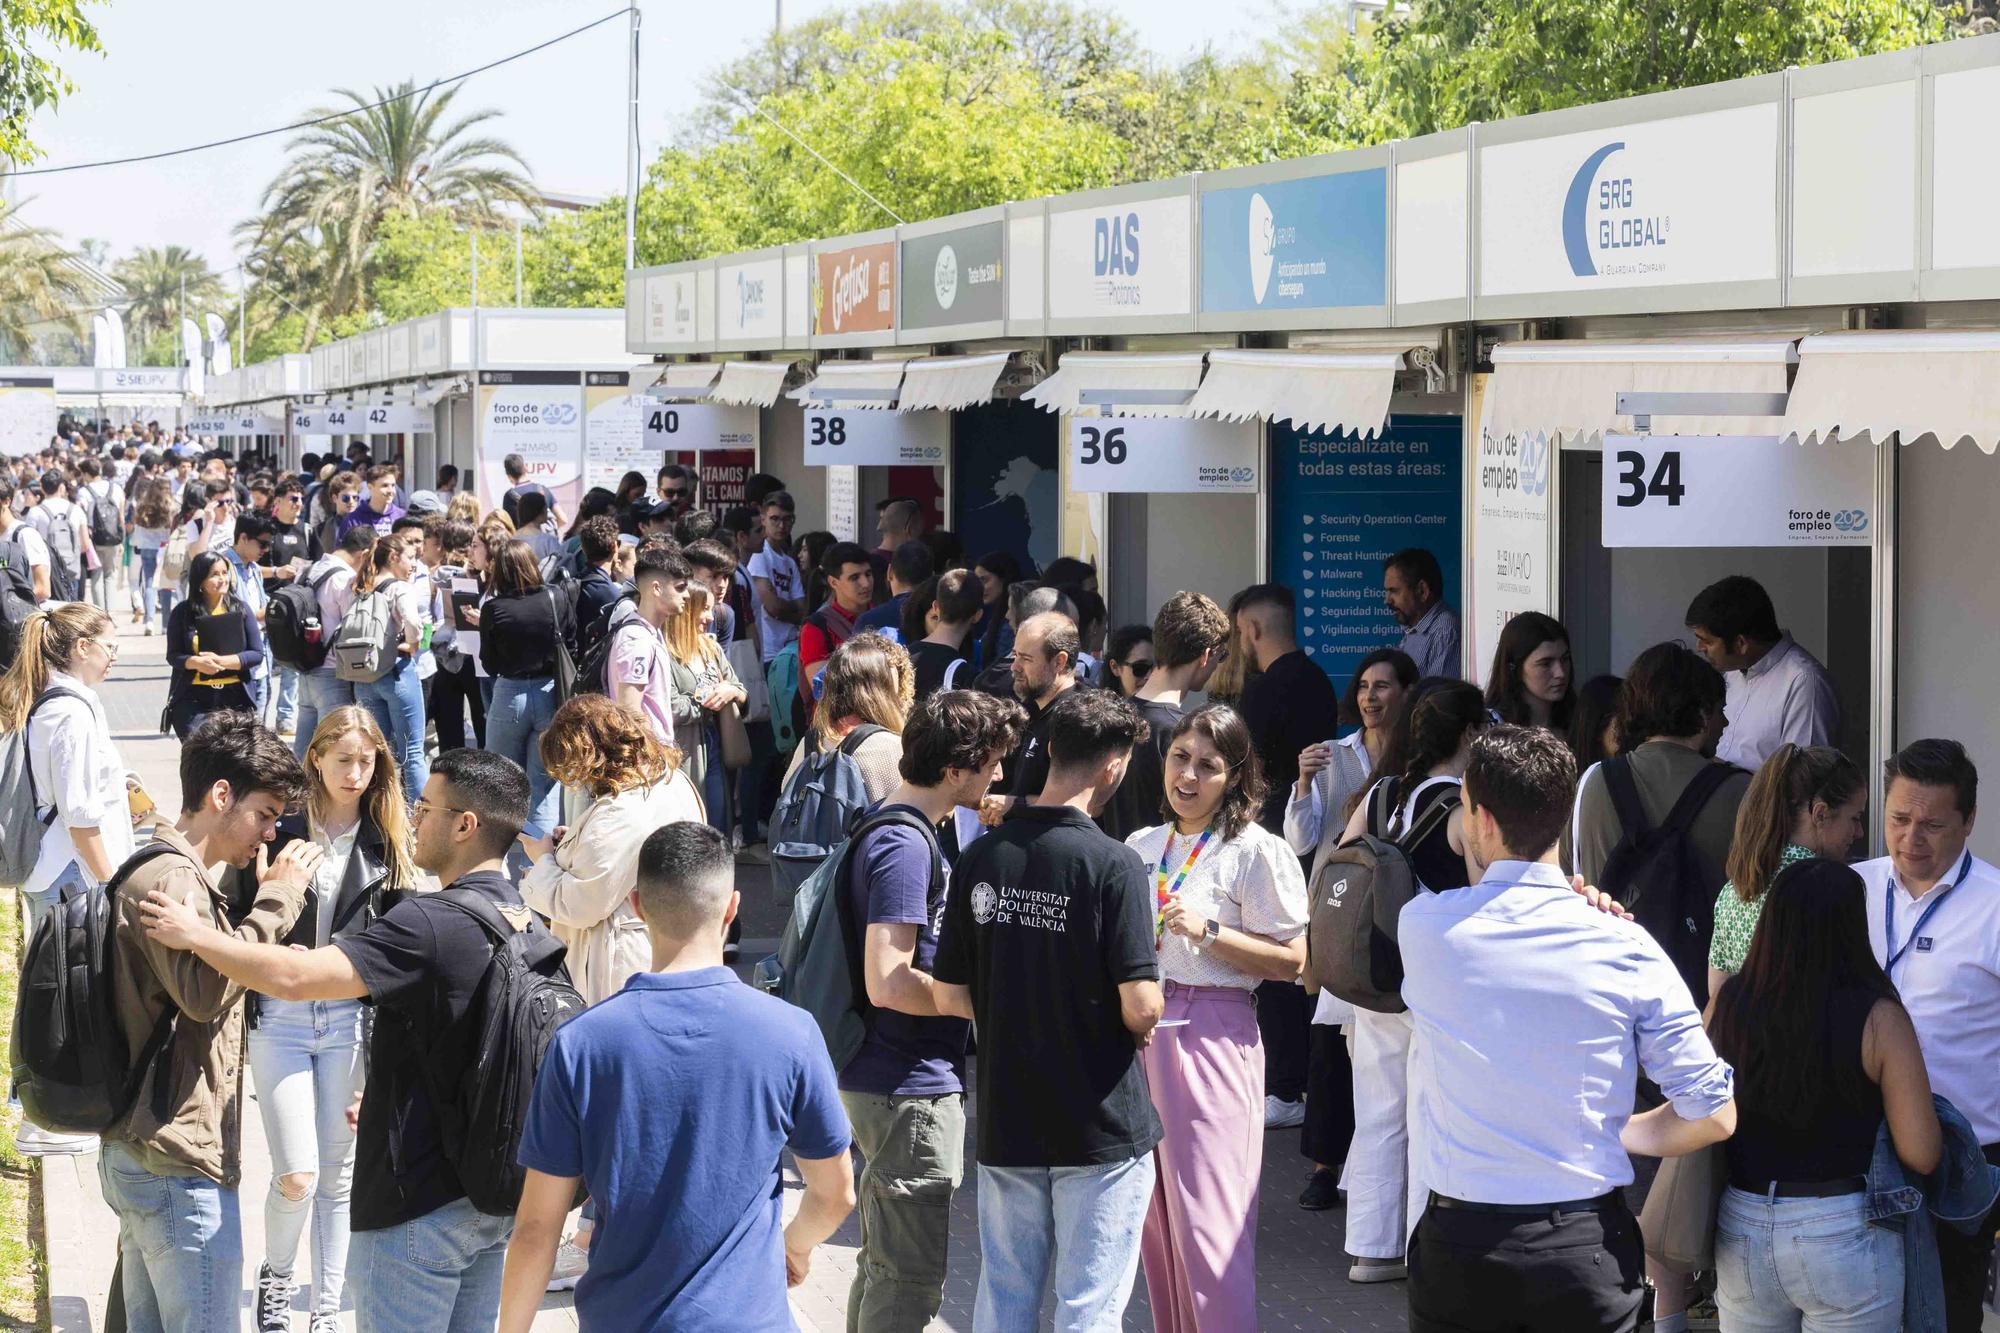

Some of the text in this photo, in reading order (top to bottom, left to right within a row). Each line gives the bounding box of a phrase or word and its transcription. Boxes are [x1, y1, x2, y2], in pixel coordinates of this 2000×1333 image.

[1600, 178, 1632, 209] SRG
[1095, 212, 1140, 276] DAS
[832, 254, 870, 331] Grefusa
[494, 402, 538, 414] foro de
[241, 419, 254, 428] 48
[295, 416, 311, 428] 46
[328, 412, 345, 425] 44
[369, 409, 387, 424] 42
[494, 414, 539, 426] empleo
[648, 410, 679, 433] 40
[811, 417, 846, 446] 38
[1080, 426, 1128, 465] 36
[1299, 439, 1429, 456] Especialízate en
[1504, 432, 1517, 456] de
[1298, 460, 1446, 475] todas estas áreas:
[1199, 474, 1230, 482] empleo
[1482, 459, 1518, 498] empleo
[1616, 450, 1685, 507] 34
[706, 485, 716, 500] EL
[1320, 514, 1447, 526] Security Operation Center
[1788, 509, 1831, 520] foro de
[1788, 520, 1832, 533] empleo
[1320, 533, 1360, 542] Forense
[1320, 550, 1353, 560] Threat
[1320, 569, 1363, 579] Malware
[1321, 588, 1361, 600] Hacking
[1321, 606, 1372, 618] Seguridad
[1321, 624, 1370, 637] Vigilancia
[634, 656, 645, 676] 3
[1001, 886, 1071, 907] UNIVERSITAT
[998, 899, 1067, 920] POLITÈCNICA
[996, 911, 1066, 933] DE VALÈNCIA
